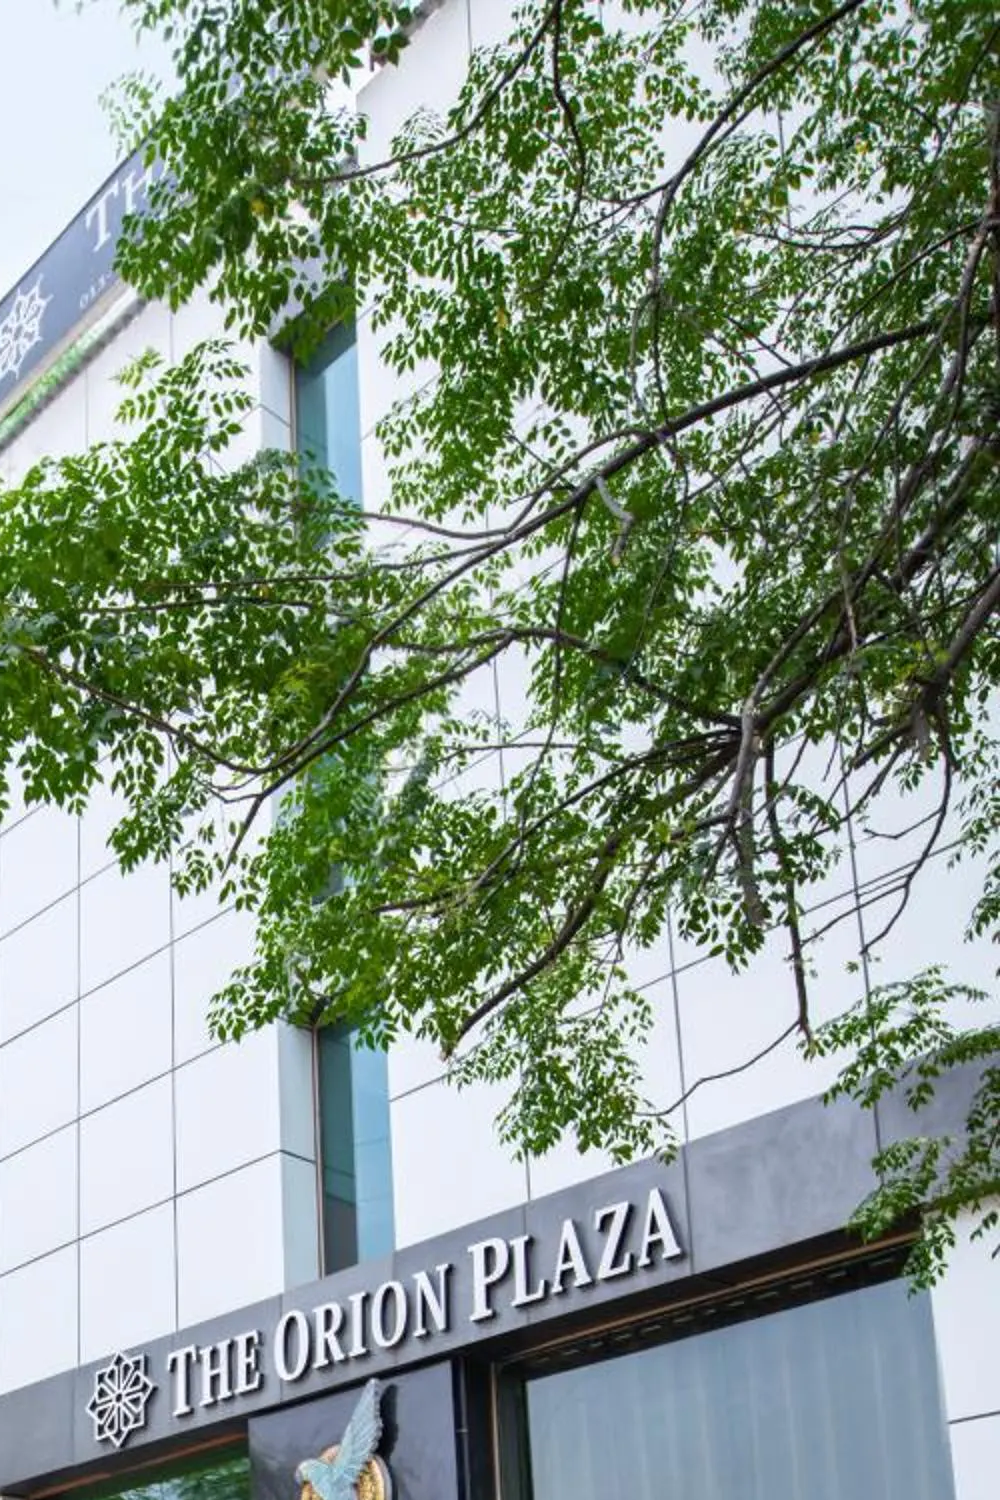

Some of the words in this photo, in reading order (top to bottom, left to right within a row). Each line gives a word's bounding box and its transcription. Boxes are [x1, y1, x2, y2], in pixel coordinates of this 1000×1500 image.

[166, 1330, 262, 1418] THE
[273, 1263, 453, 1382] ORION
[467, 1187, 684, 1322] PLAZA
